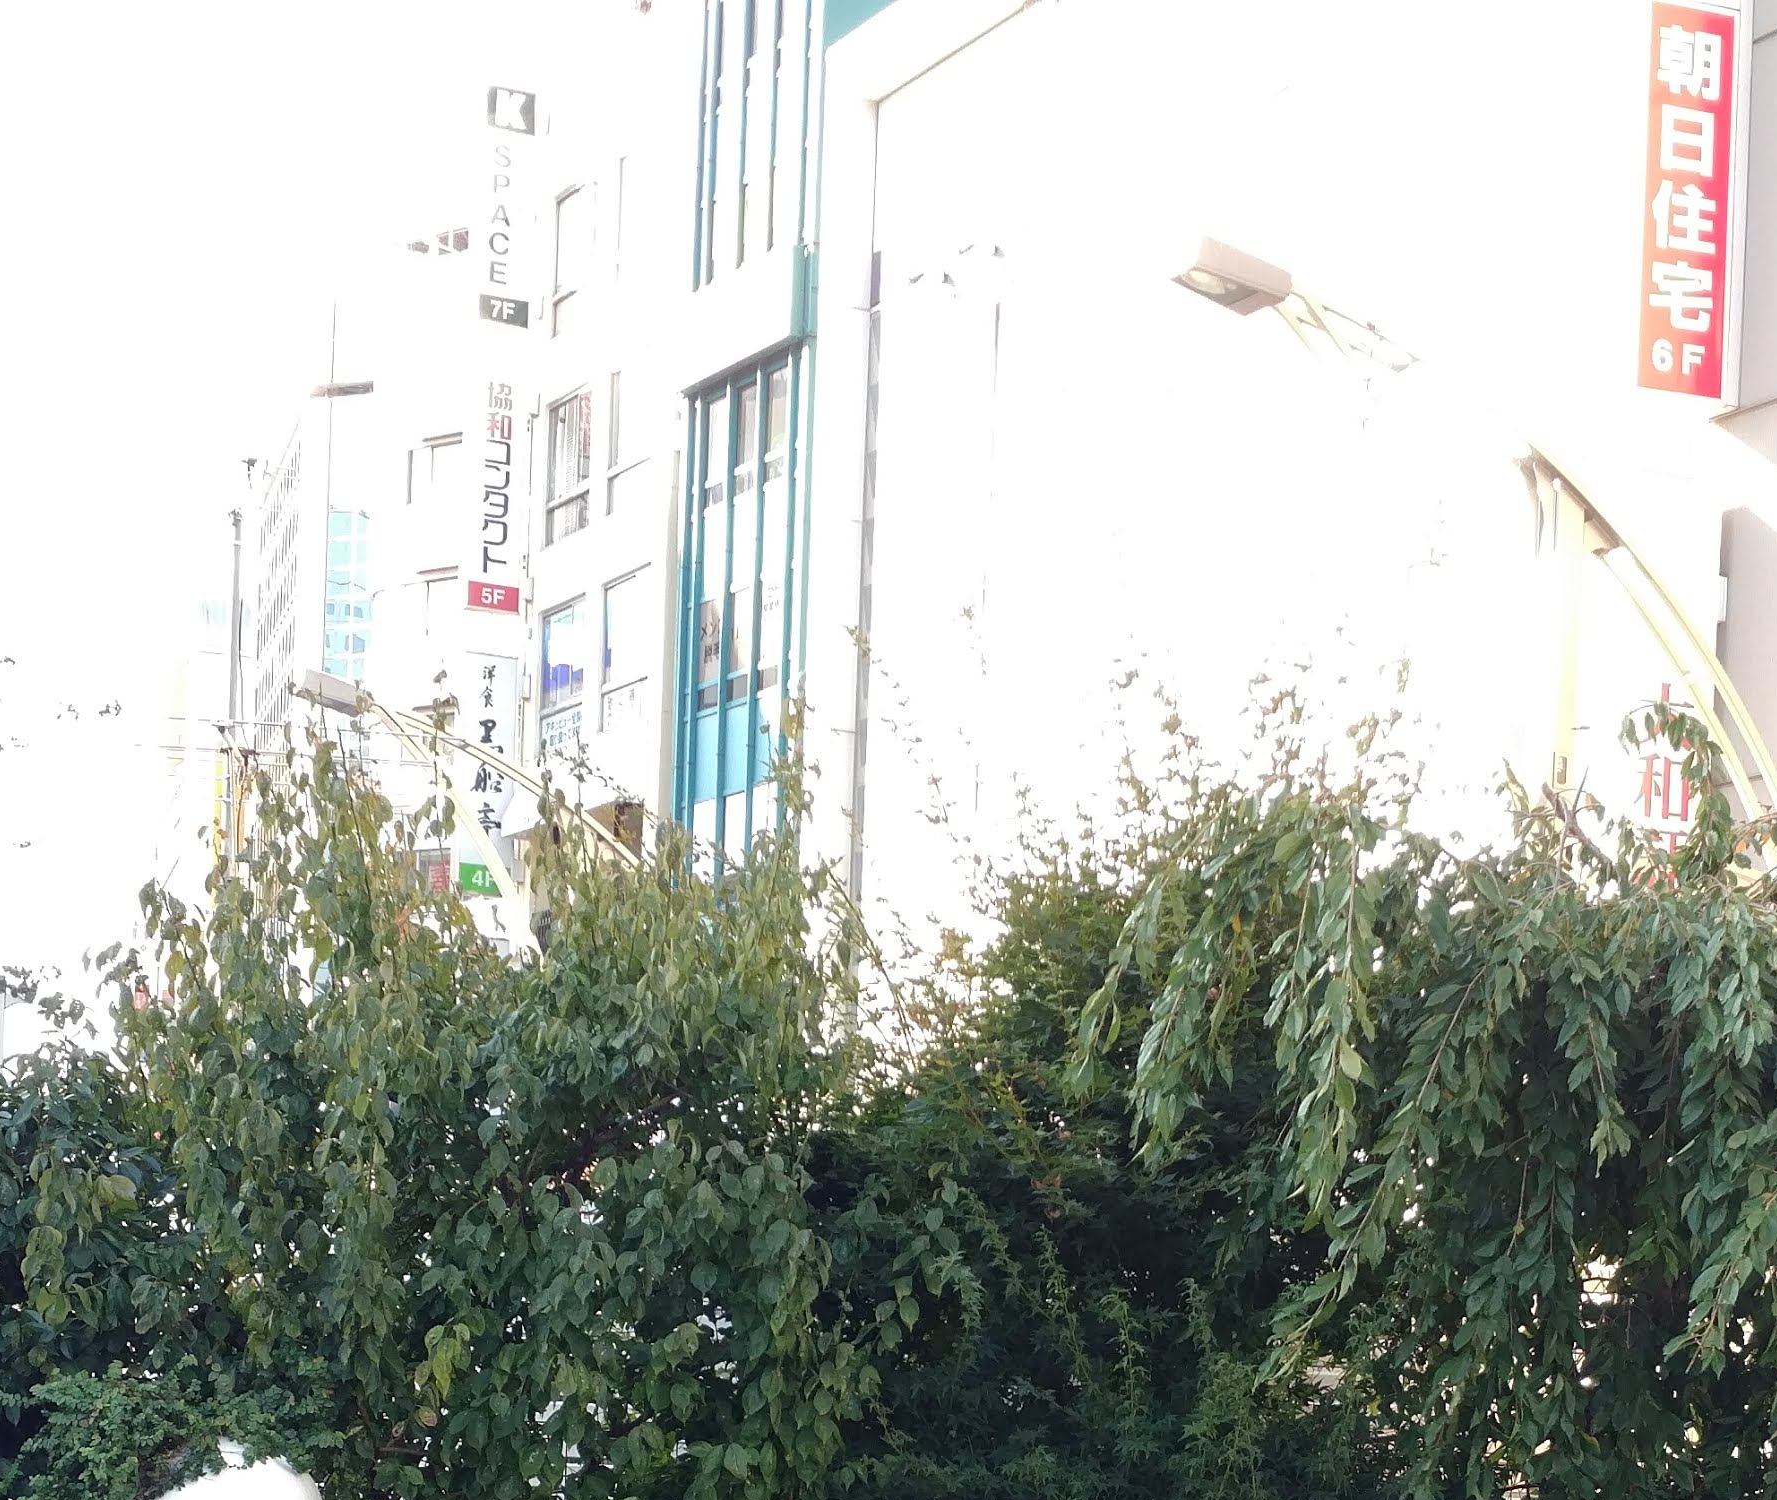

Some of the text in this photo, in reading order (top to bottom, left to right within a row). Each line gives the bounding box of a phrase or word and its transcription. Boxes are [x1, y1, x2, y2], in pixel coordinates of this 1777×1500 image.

[488, 88, 527, 285] K SPACE
[1648, 22, 1723, 336] 朝日住宅
[489, 298, 517, 322] 7F
[1651, 338, 1707, 377] 6F
[481, 380, 513, 574] 協和コンタクト
[480, 587, 507, 606] 5F
[479, 664, 497, 708] 洋食
